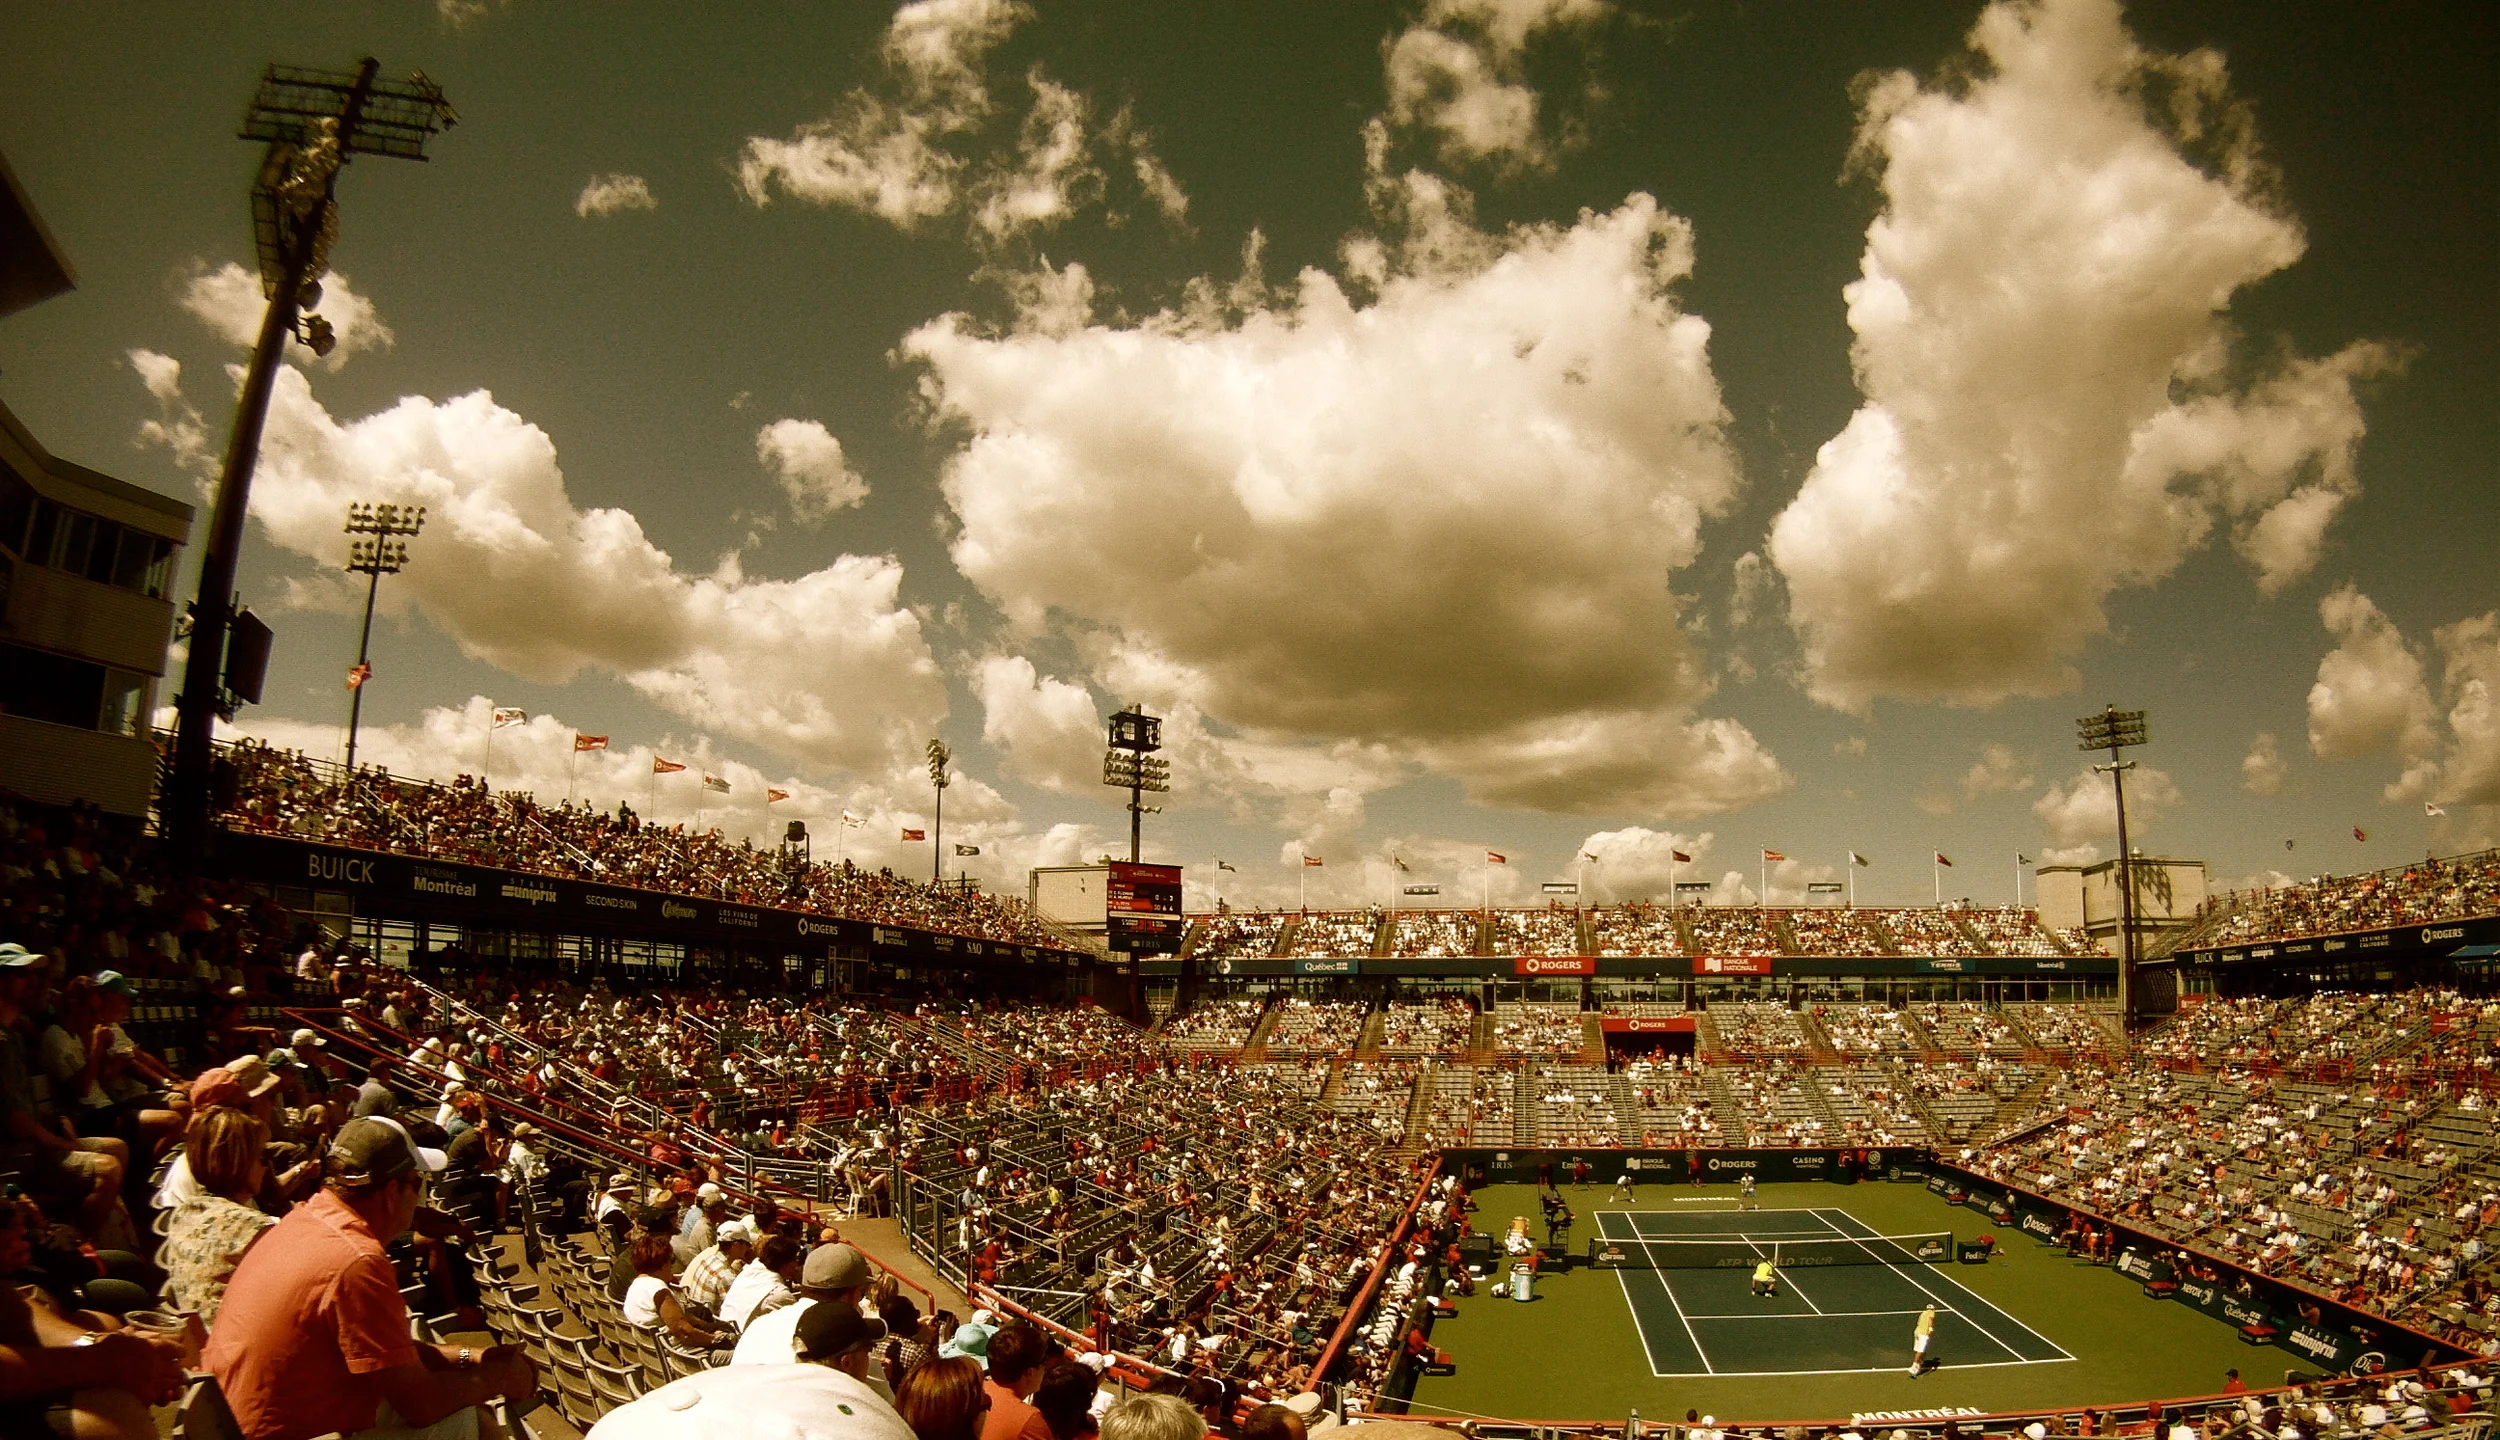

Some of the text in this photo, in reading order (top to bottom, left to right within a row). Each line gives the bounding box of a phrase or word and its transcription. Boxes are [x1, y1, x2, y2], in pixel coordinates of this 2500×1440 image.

[308, 854, 375, 884] BUICK
[414, 876, 477, 897] Montréal
[514, 887, 557, 906] uniprix
[586, 895, 637, 910] SECOND SKIN
[810, 923, 838, 935] ROGERS
[2431, 928, 2464, 940] ROGERS
[1304, 962, 1336, 973] Québec
[1541, 961, 1582, 969] ROGERS
[1491, 1161, 1513, 1169] IRIS
[1715, 1258, 1743, 1267] ATP
[1799, 1256, 1834, 1265] TOUR
[1851, 1406, 1989, 1421] MONTRÉAL
